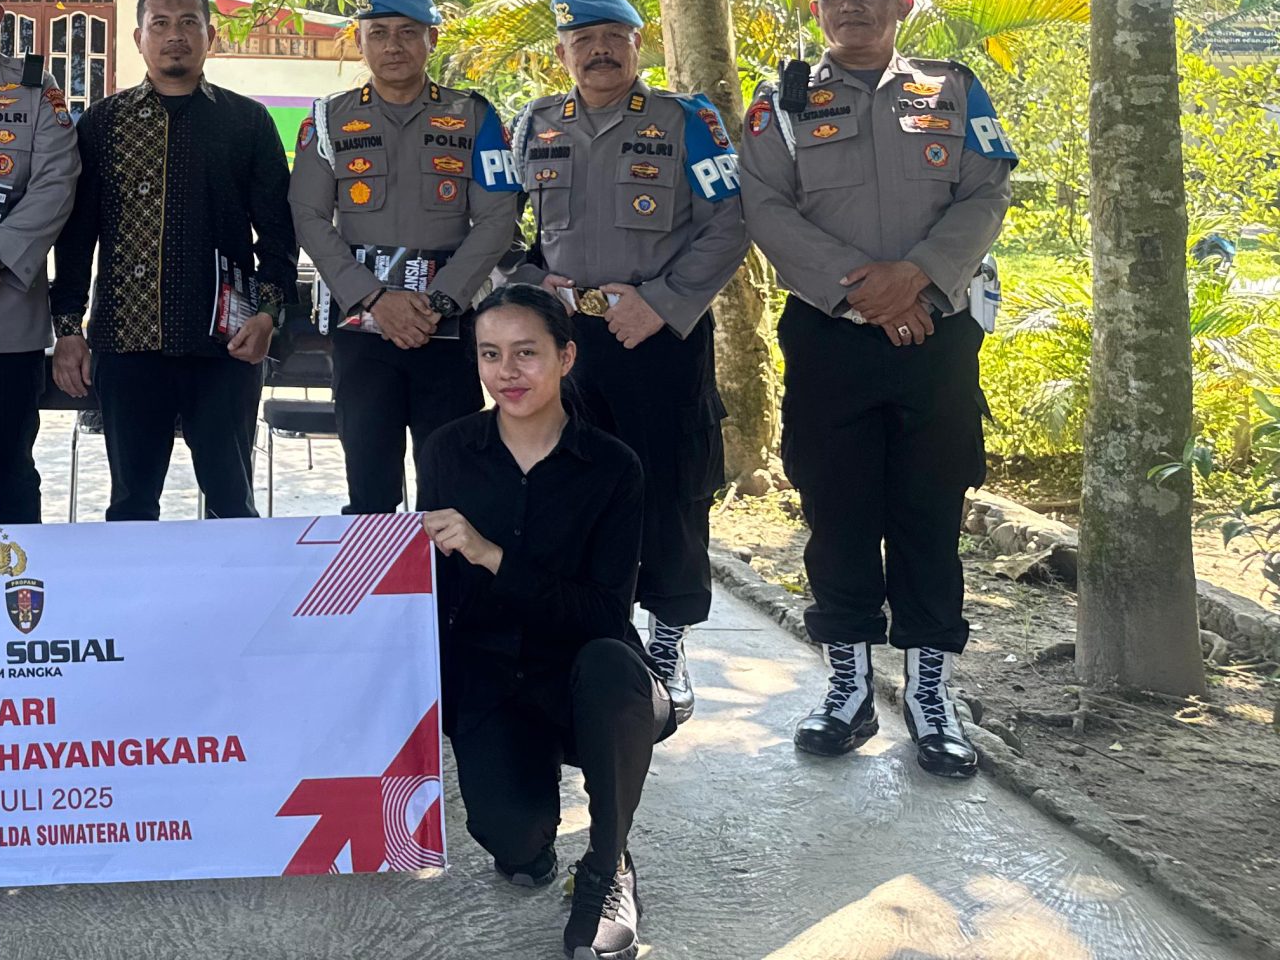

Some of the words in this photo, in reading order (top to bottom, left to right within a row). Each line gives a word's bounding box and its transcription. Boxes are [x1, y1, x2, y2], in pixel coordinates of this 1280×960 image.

[424, 133, 472, 150] POLRI
[621, 142, 673, 157] POLRI
[690, 153, 740, 199] PR
[404, 256, 423, 292] ANSIA,
[6, 638, 125, 664] SOSIAL
[8, 666, 63, 679] RANGKA
[51, 786, 114, 811] 2025
[36, 821, 131, 846] SUMATERA
[136, 820, 192, 842] UTARA
